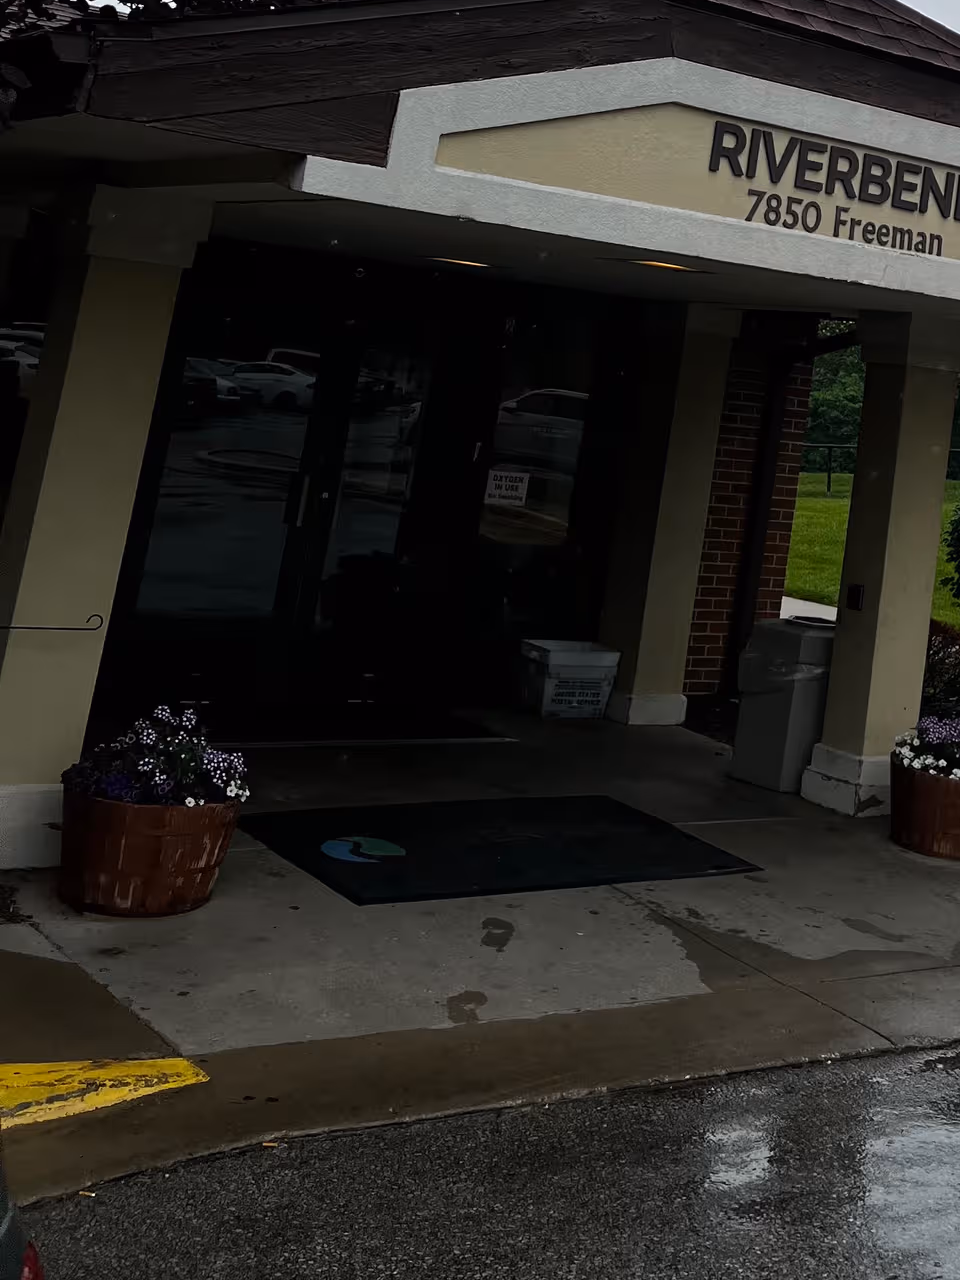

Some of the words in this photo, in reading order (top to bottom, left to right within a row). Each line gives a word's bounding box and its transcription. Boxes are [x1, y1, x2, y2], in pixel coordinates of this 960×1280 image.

[745, 188, 822, 233] 7850
[833, 205, 943, 257] Freeman
[493, 474, 524, 483] OXYGEN
